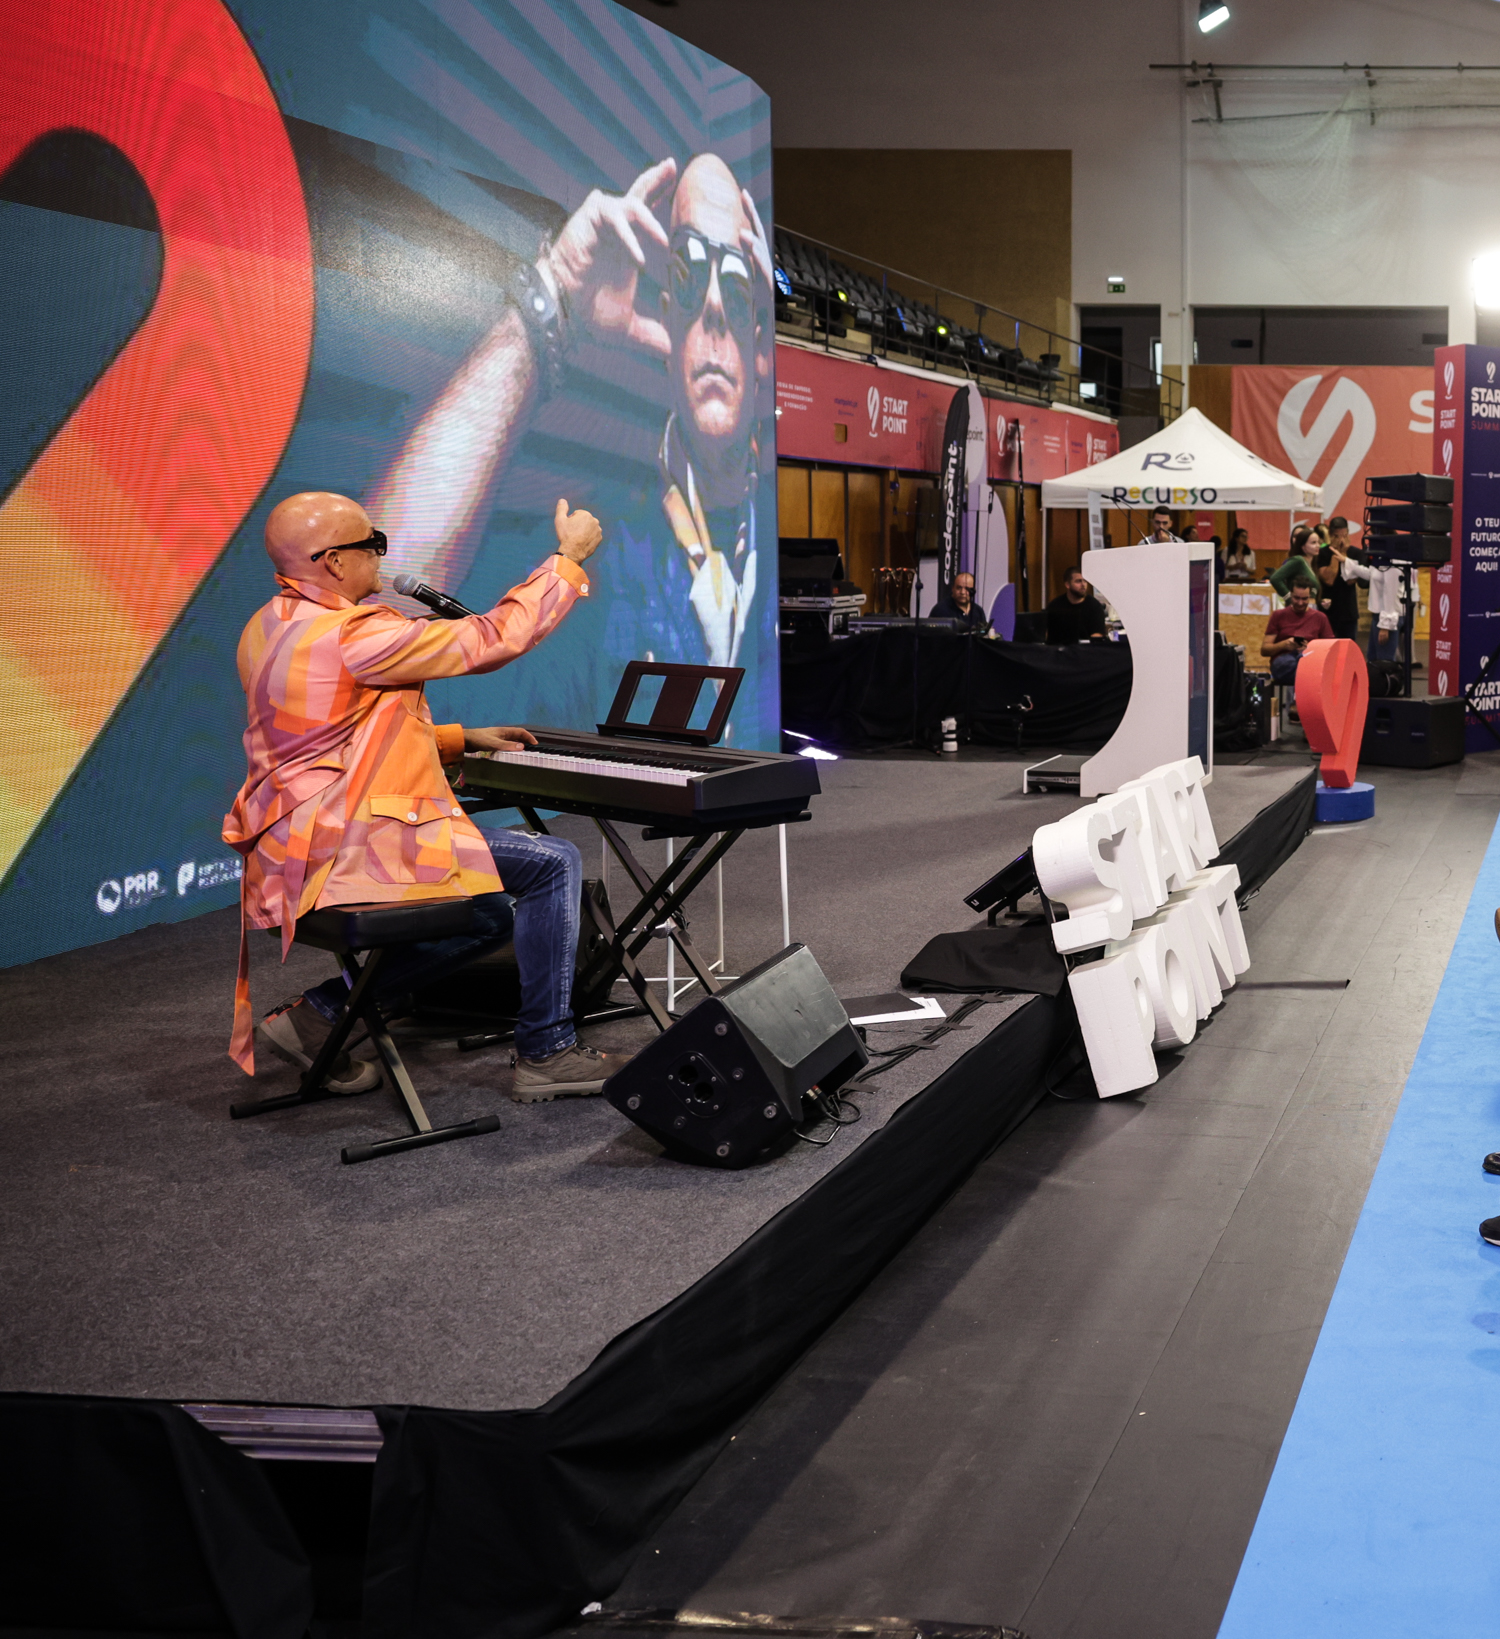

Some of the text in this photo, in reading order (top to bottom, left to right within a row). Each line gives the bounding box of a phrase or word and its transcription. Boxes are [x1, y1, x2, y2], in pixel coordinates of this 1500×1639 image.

[882, 396, 909, 416] START
[1440, 408, 1456, 419] START
[882, 415, 908, 434] POINT
[1440, 419, 1456, 429] POINT
[1475, 517, 1500, 528] O TEU
[1475, 561, 1498, 572] AQUI!
[1437, 574, 1453, 584] POINT
[1436, 640, 1452, 651] START
[1435, 650, 1451, 661] POINT
[1033, 755, 1220, 955] START
[124, 870, 159, 898] PRR
[1068, 864, 1251, 1098] POINT
